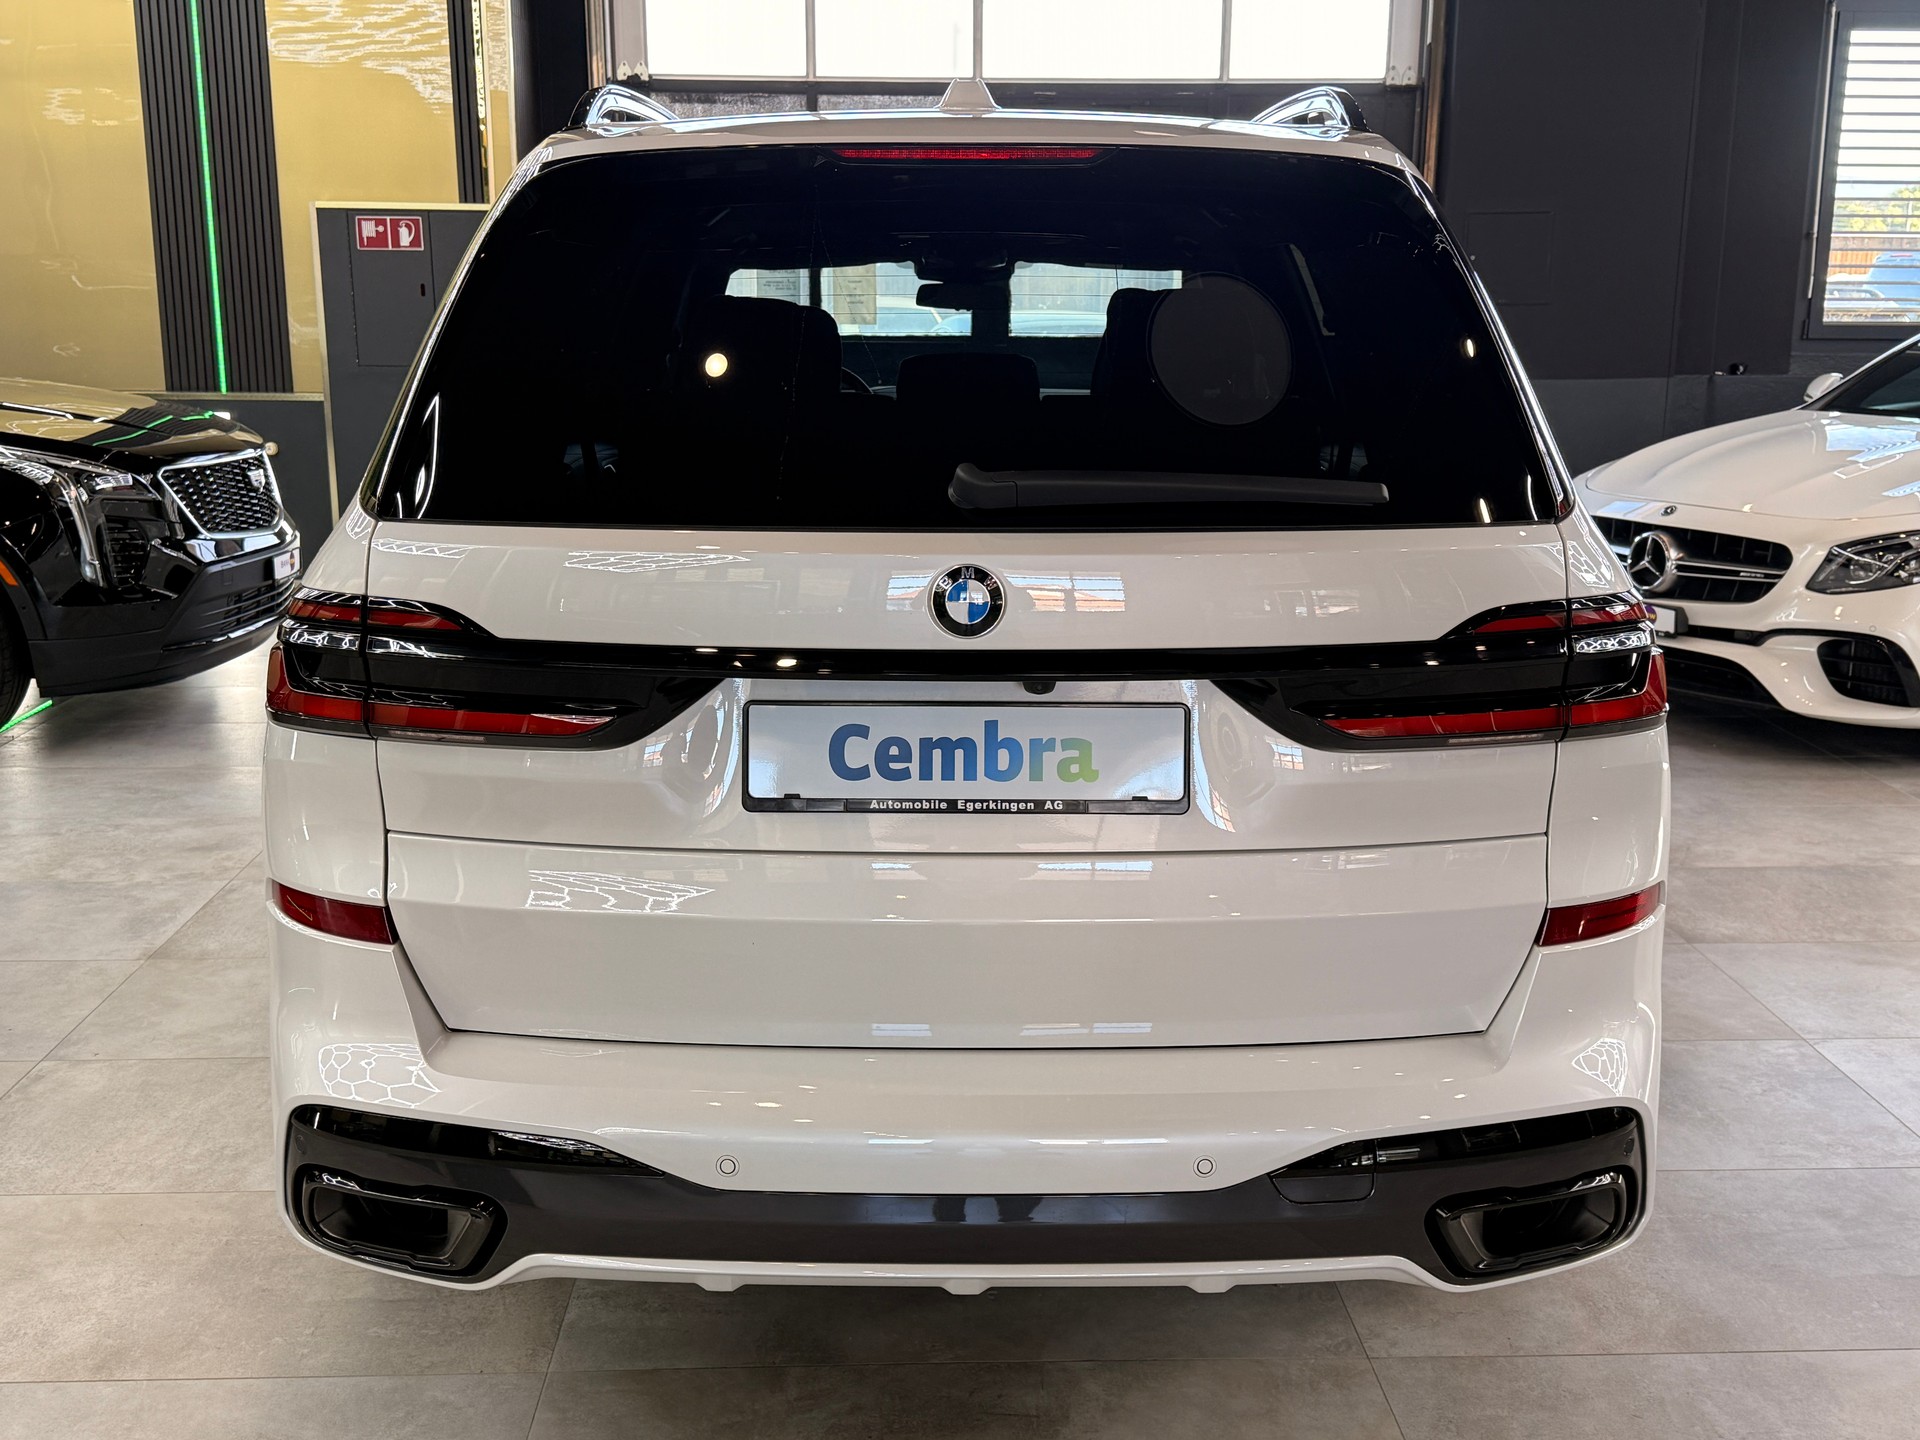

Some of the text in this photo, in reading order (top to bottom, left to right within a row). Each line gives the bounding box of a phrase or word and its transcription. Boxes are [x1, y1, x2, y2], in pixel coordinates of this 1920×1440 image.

[938, 567, 998, 591] BMW
[828, 719, 1100, 783] Cembra
[869, 799, 1064, 813] Automobile Egerkingen AG
